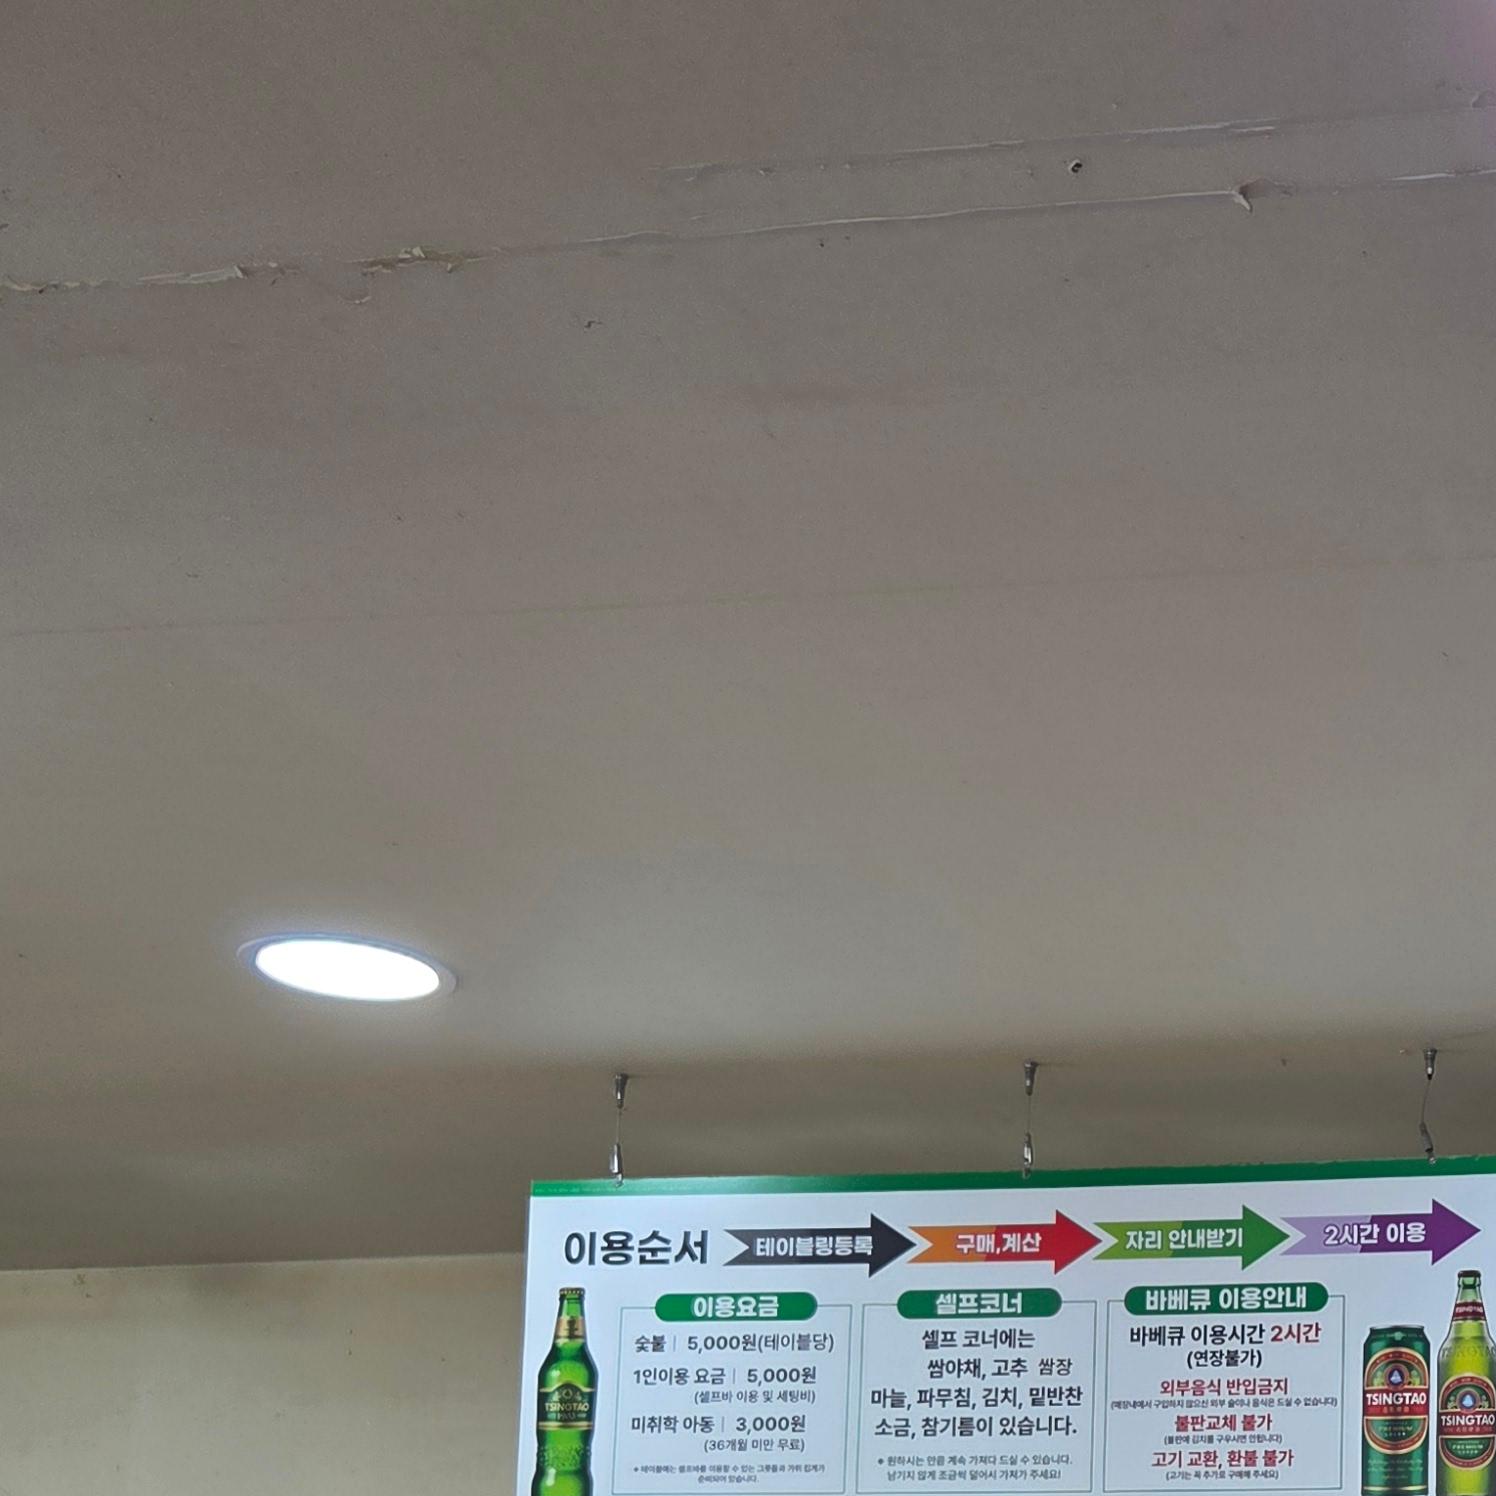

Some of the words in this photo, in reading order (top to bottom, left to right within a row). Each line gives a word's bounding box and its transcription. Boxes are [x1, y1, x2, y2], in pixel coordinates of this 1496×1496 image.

[955, 1232, 1043, 1256] 구매,계산
[1125, 1230, 1162, 1251] 자리
[1168, 1228, 1243, 1249] 안내받기
[1324, 1224, 1380, 1246] 2시간
[1386, 1222, 1426, 1244] 이용
[564, 1229, 708, 1267] 이용순서
[755, 1234, 874, 1257] 테이블링등록
[693, 1295, 780, 1318] 이용요금
[934, 1293, 1023, 1316] 셀프코너
[1145, 1288, 1211, 1312] 바베큐
[1218, 1286, 1307, 1310] 이용안내
[634, 1335, 666, 1353] 숯불
[687, 1333, 835, 1354] 5,000원(테이블당)
[922, 1330, 958, 1349] 셀프
[962, 1328, 1035, 1349] 코너에는
[1130, 1325, 1186, 1346] 바베큐
[1191, 1324, 1266, 1345] 이용시간
[1270, 1322, 1322, 1343] 2시간
[927, 1358, 986, 1380] 쌈야채,
[991, 1358, 1028, 1378] 고추
[1038, 1357, 1072, 1376] 쌈장
[1187, 1349, 1263, 1369] (연장불가)
[633, 1367, 690, 1386] 1인이용
[694, 1368, 726, 1385] 요금
[747, 1365, 817, 1387] 5,000원
[1160, 1379, 1221, 1397] 외부음식
[1226, 1377, 1289, 1396] 반입금지
[694, 1390, 733, 1404] (셀프바
[736, 1390, 759, 1403] 이용
[776, 1390, 816, 1404] 세팅비)
[871, 1388, 912, 1411] 마늘,
[916, 1387, 977, 1410] 파무침,
[982, 1386, 1023, 1410] 김치,
[1029, 1386, 1083, 1407] 밑반찬
[1366, 1392, 1427, 1406] TSINGTAO
[631, 1415, 679, 1434] 미취학
[683, 1415, 715, 1434] 아동
[736, 1414, 806, 1435] 3,000원
[874, 1418, 916, 1440] 소금,
[921, 1416, 994, 1437] 참기름이
[999, 1415, 1078, 1438] 있습니다.
[1174, 1414, 1237, 1432] 불판교체
[1241, 1413, 1272, 1431] 불가
[1441, 1415, 1496, 1426] TSINGTAO
[751, 1439, 774, 1452] 미만
[777, 1438, 805, 1452] 무료)
[999, 1454, 1018, 1466] 드실
[1020, 1455, 1030, 1466] 수
[1032, 1454, 1073, 1466] 있습니다.
[1151, 1451, 1182, 1468] 고기
[1187, 1450, 1222, 1470] 교환,
[1226, 1449, 1258, 1468] 환불
[1262, 1449, 1294, 1467] 불가
